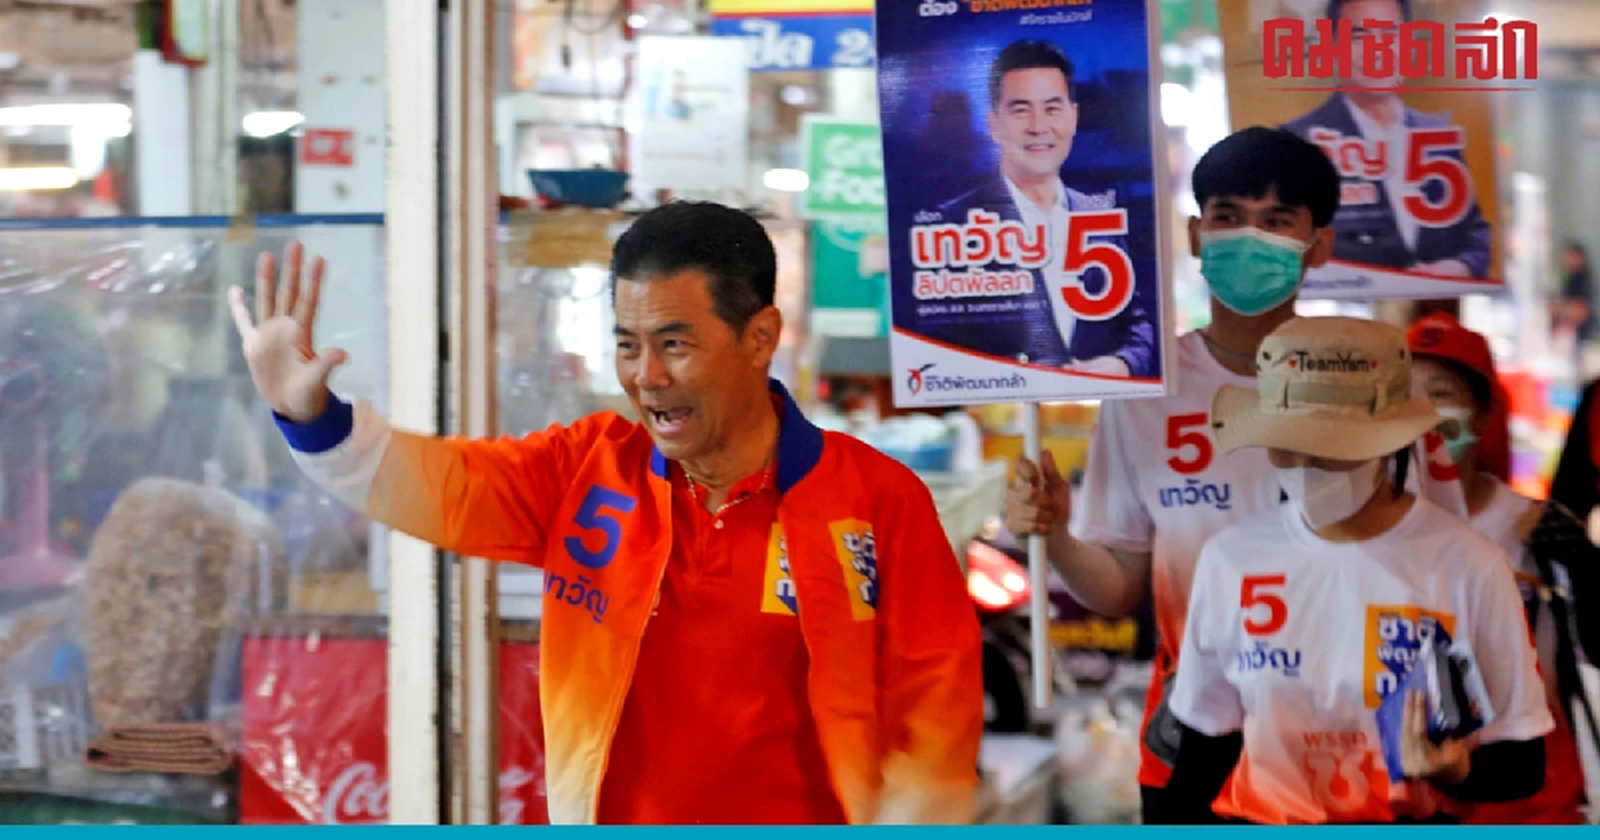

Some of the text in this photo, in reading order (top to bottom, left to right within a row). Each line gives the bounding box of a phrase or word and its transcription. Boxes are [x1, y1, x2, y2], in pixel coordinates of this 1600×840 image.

[1402, 129, 1468, 225] 5
[913, 211, 1131, 317] เทวัญ 5
[1295, 351, 1370, 373] TeamYam
[1166, 412, 1214, 475] 5
[1160, 479, 1232, 510] เทวัญ
[564, 484, 637, 569] 5
[1241, 574, 1288, 636] 5
